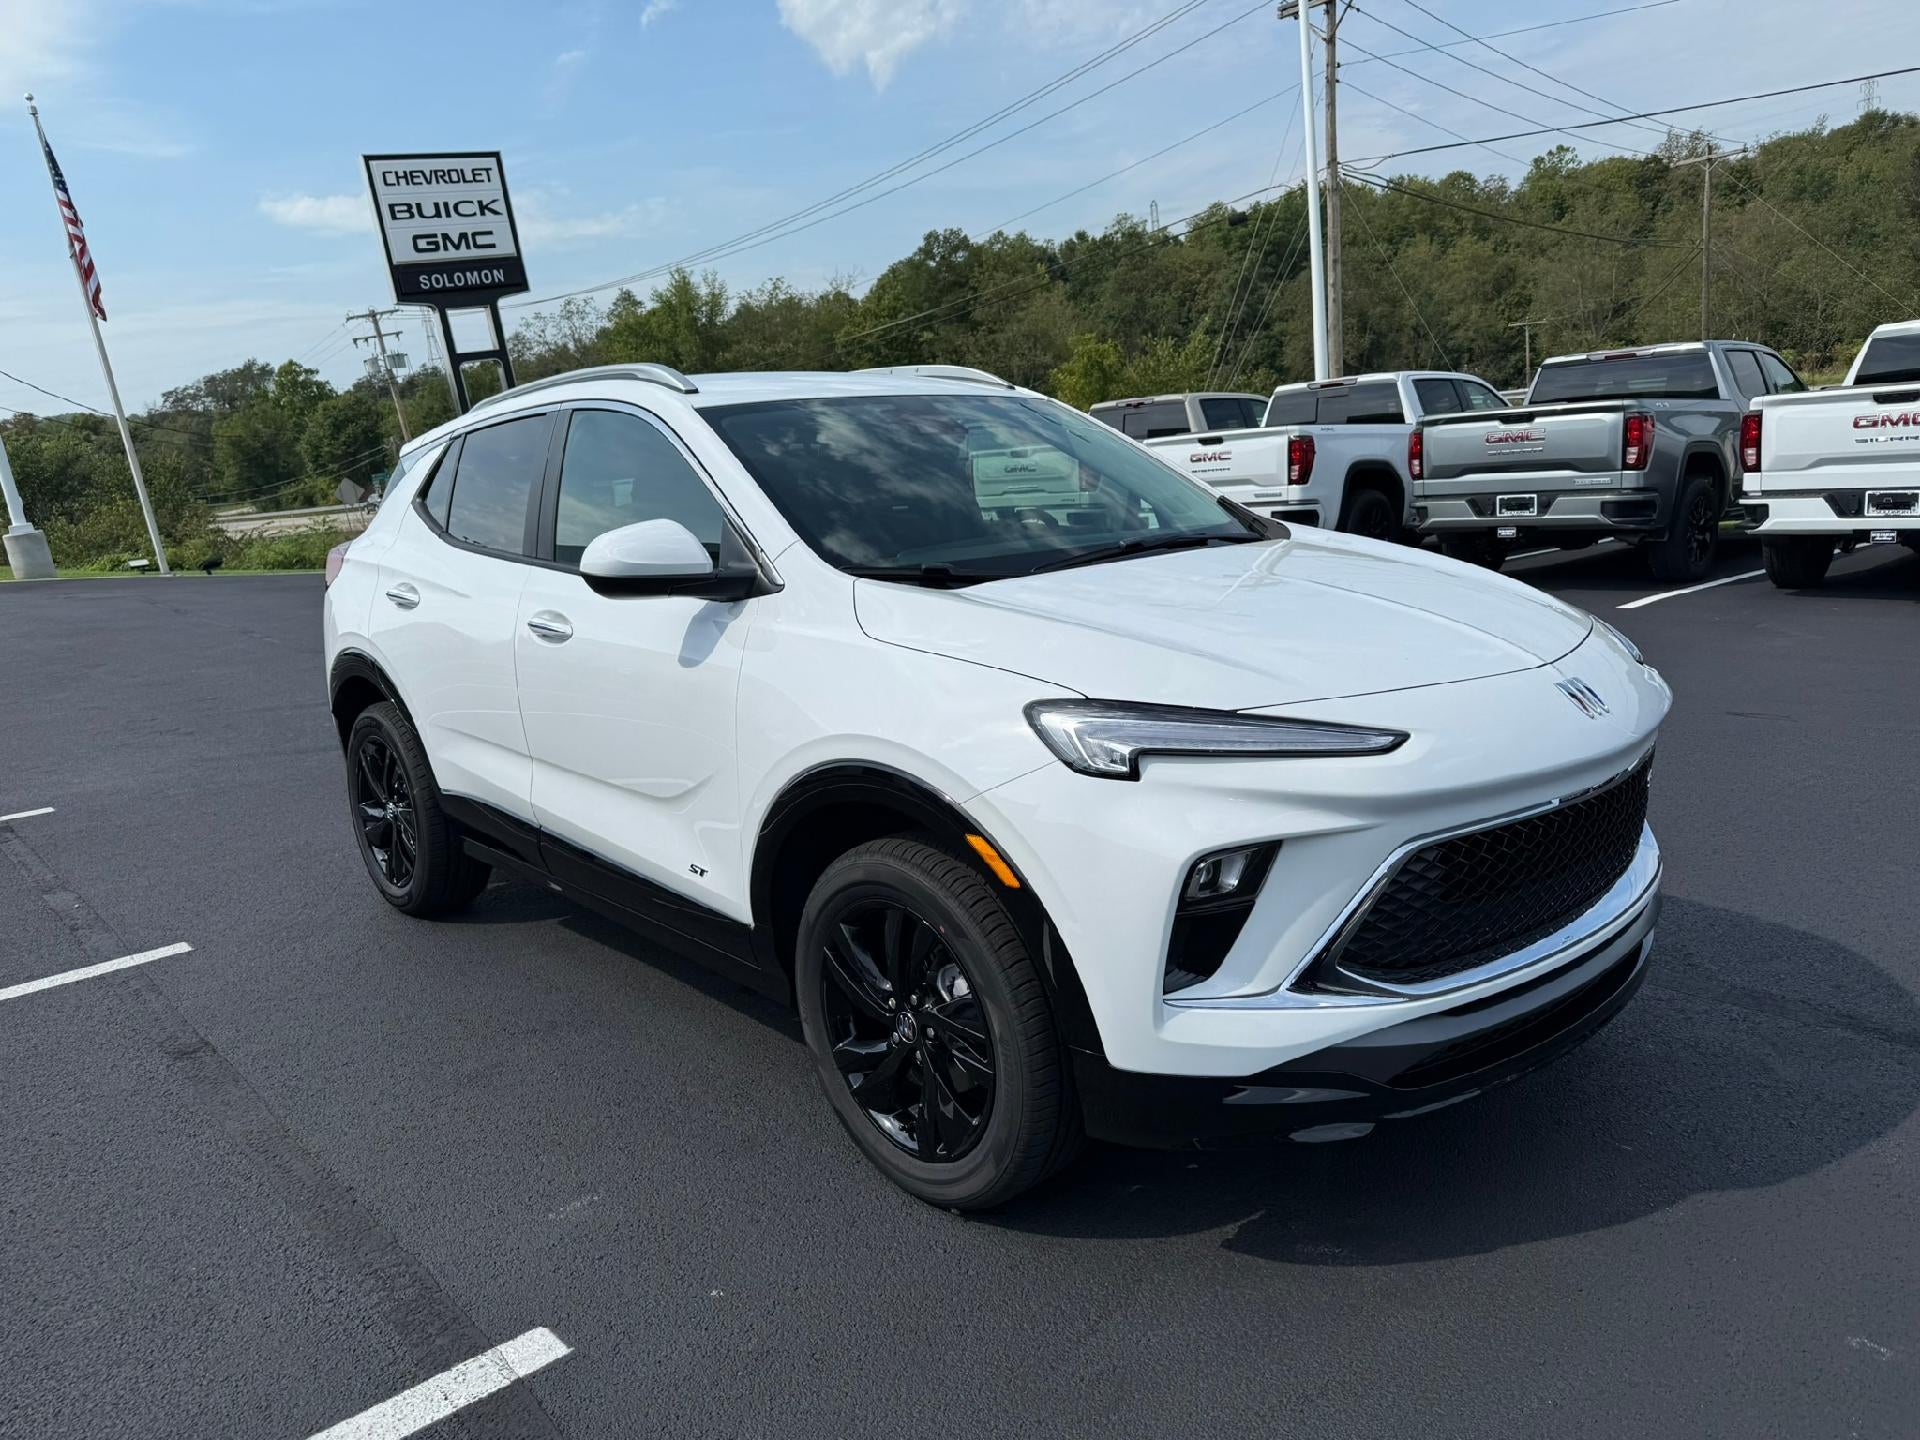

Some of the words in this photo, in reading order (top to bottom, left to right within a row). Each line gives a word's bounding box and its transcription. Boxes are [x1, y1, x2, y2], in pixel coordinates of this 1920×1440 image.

[382, 167, 492, 187] CHEVROLET
[388, 198, 503, 221] BUICK
[412, 231, 496, 253] GMC
[419, 268, 505, 289] SOLOMON
[1485, 428, 1546, 445] GMC
[1190, 450, 1233, 463] GMC
[688, 863, 709, 878] ST
